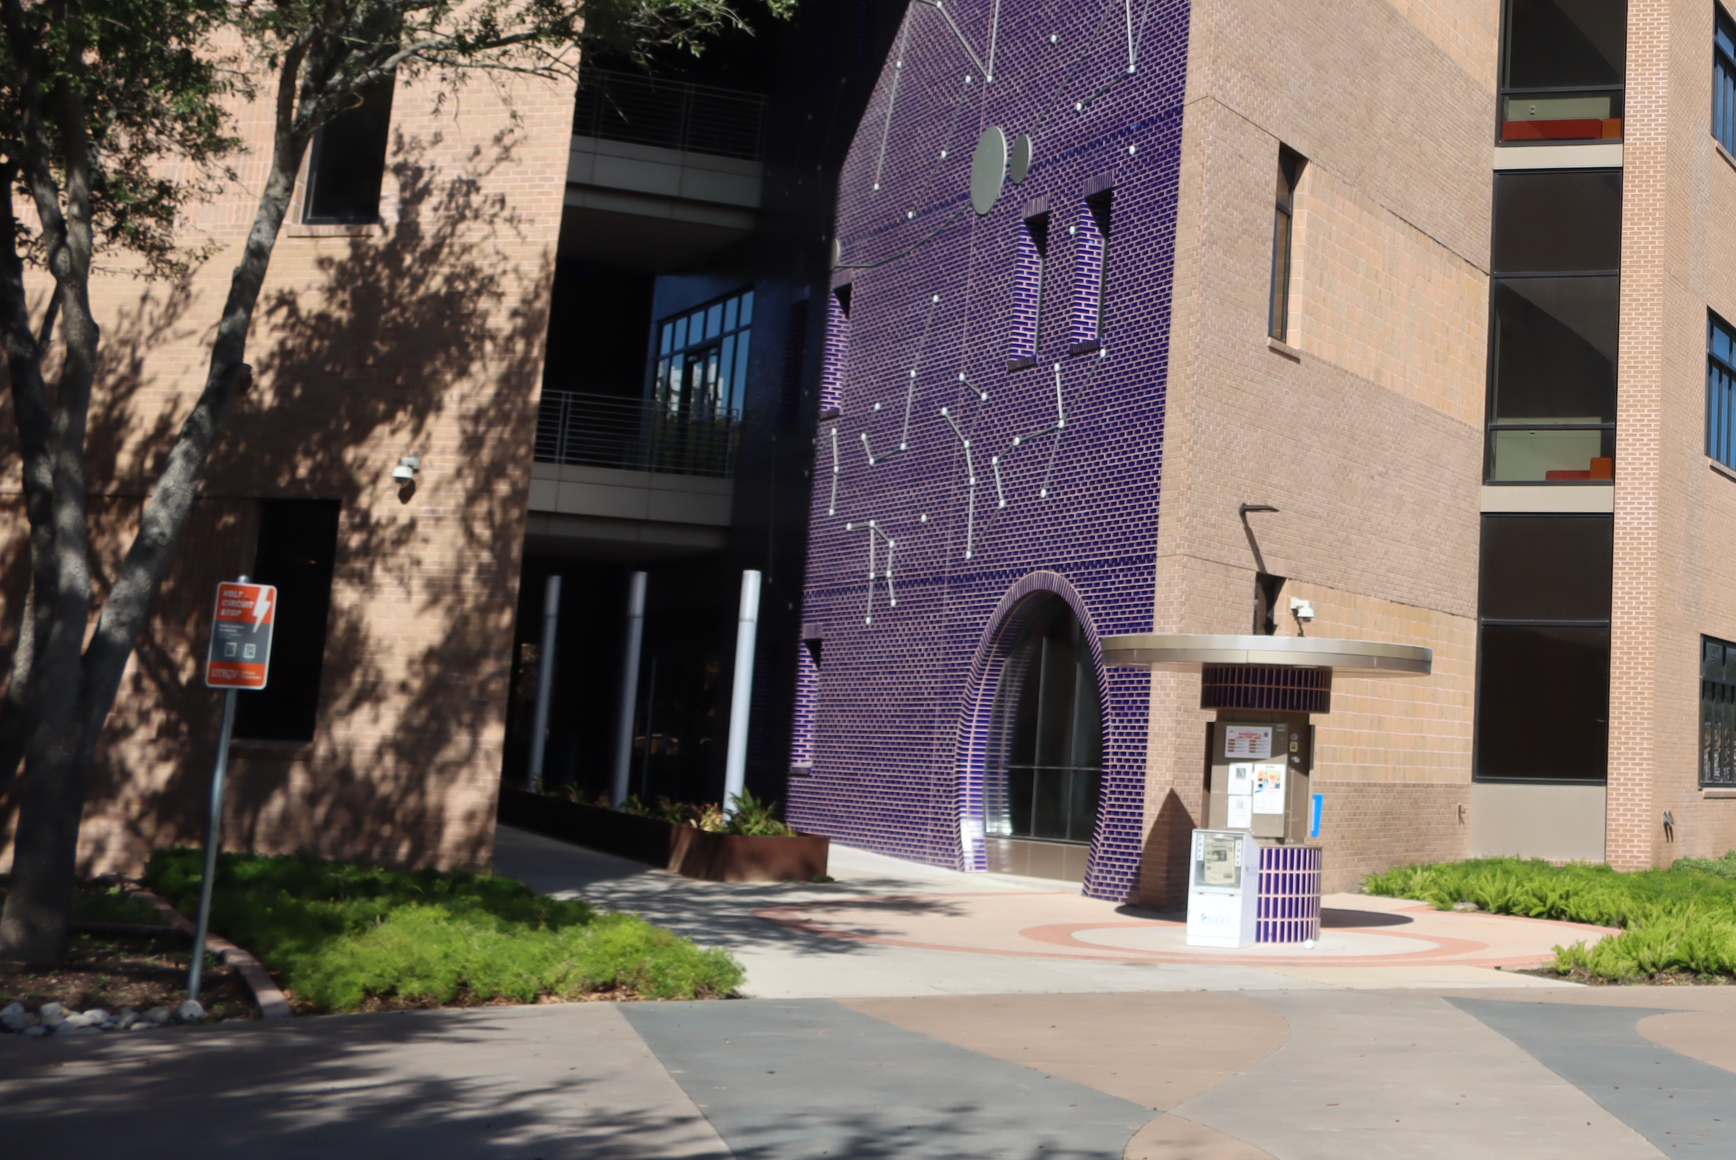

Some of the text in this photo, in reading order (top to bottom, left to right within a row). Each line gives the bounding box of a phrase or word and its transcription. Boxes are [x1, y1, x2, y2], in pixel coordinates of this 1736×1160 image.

[223, 590, 243, 598] VOLT
[221, 599, 254, 608] CIRCUIT
[220, 608, 242, 616] STOP
